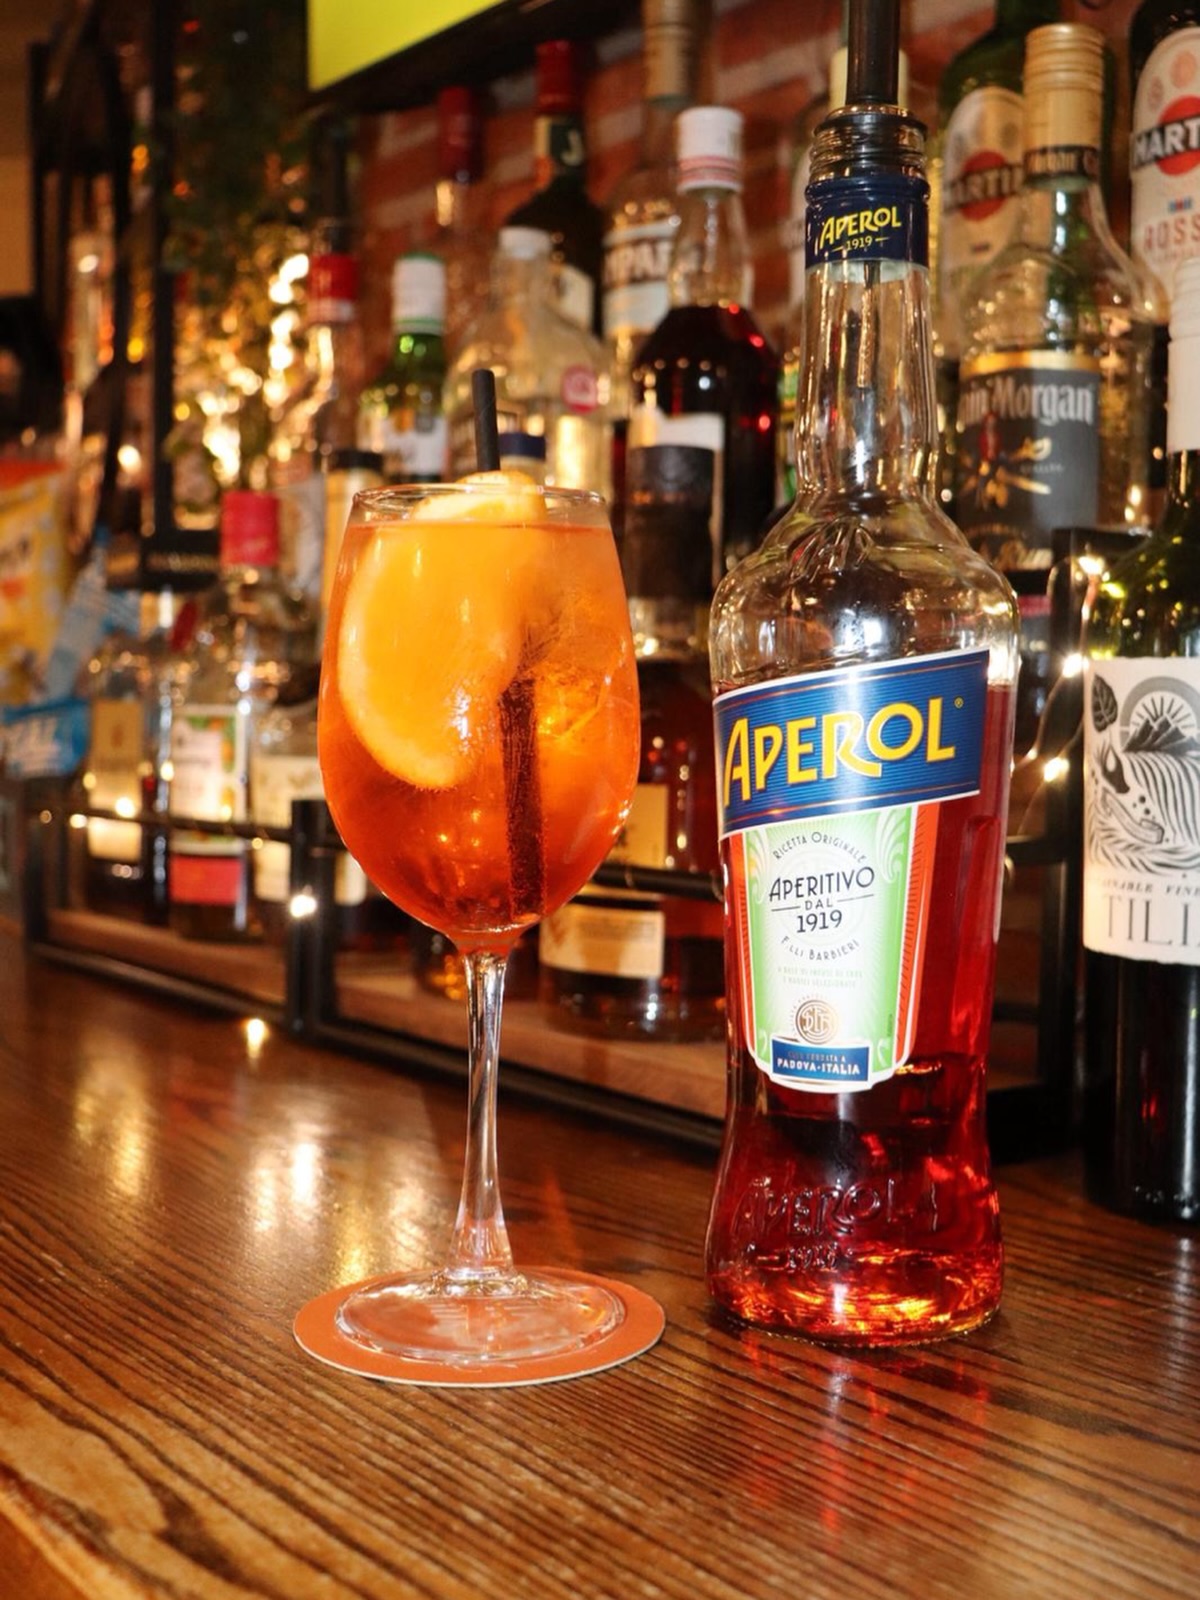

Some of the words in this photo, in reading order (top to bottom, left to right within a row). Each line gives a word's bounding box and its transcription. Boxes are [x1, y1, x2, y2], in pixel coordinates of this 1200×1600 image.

[819, 206, 902, 250] APEROL
[845, 235, 873, 250] 1919
[991, 376, 1094, 427] Morgan
[723, 697, 957, 808] APEROL
[772, 835, 808, 860] RICETTA
[811, 831, 867, 863] ORIGINALE
[769, 866, 875, 902] APERITIVO
[797, 909, 843, 934] 1919
[804, 898, 834, 911] DAL
[1102, 894, 1200, 947] TILI
[808, 939, 861, 961] BARBIERI
